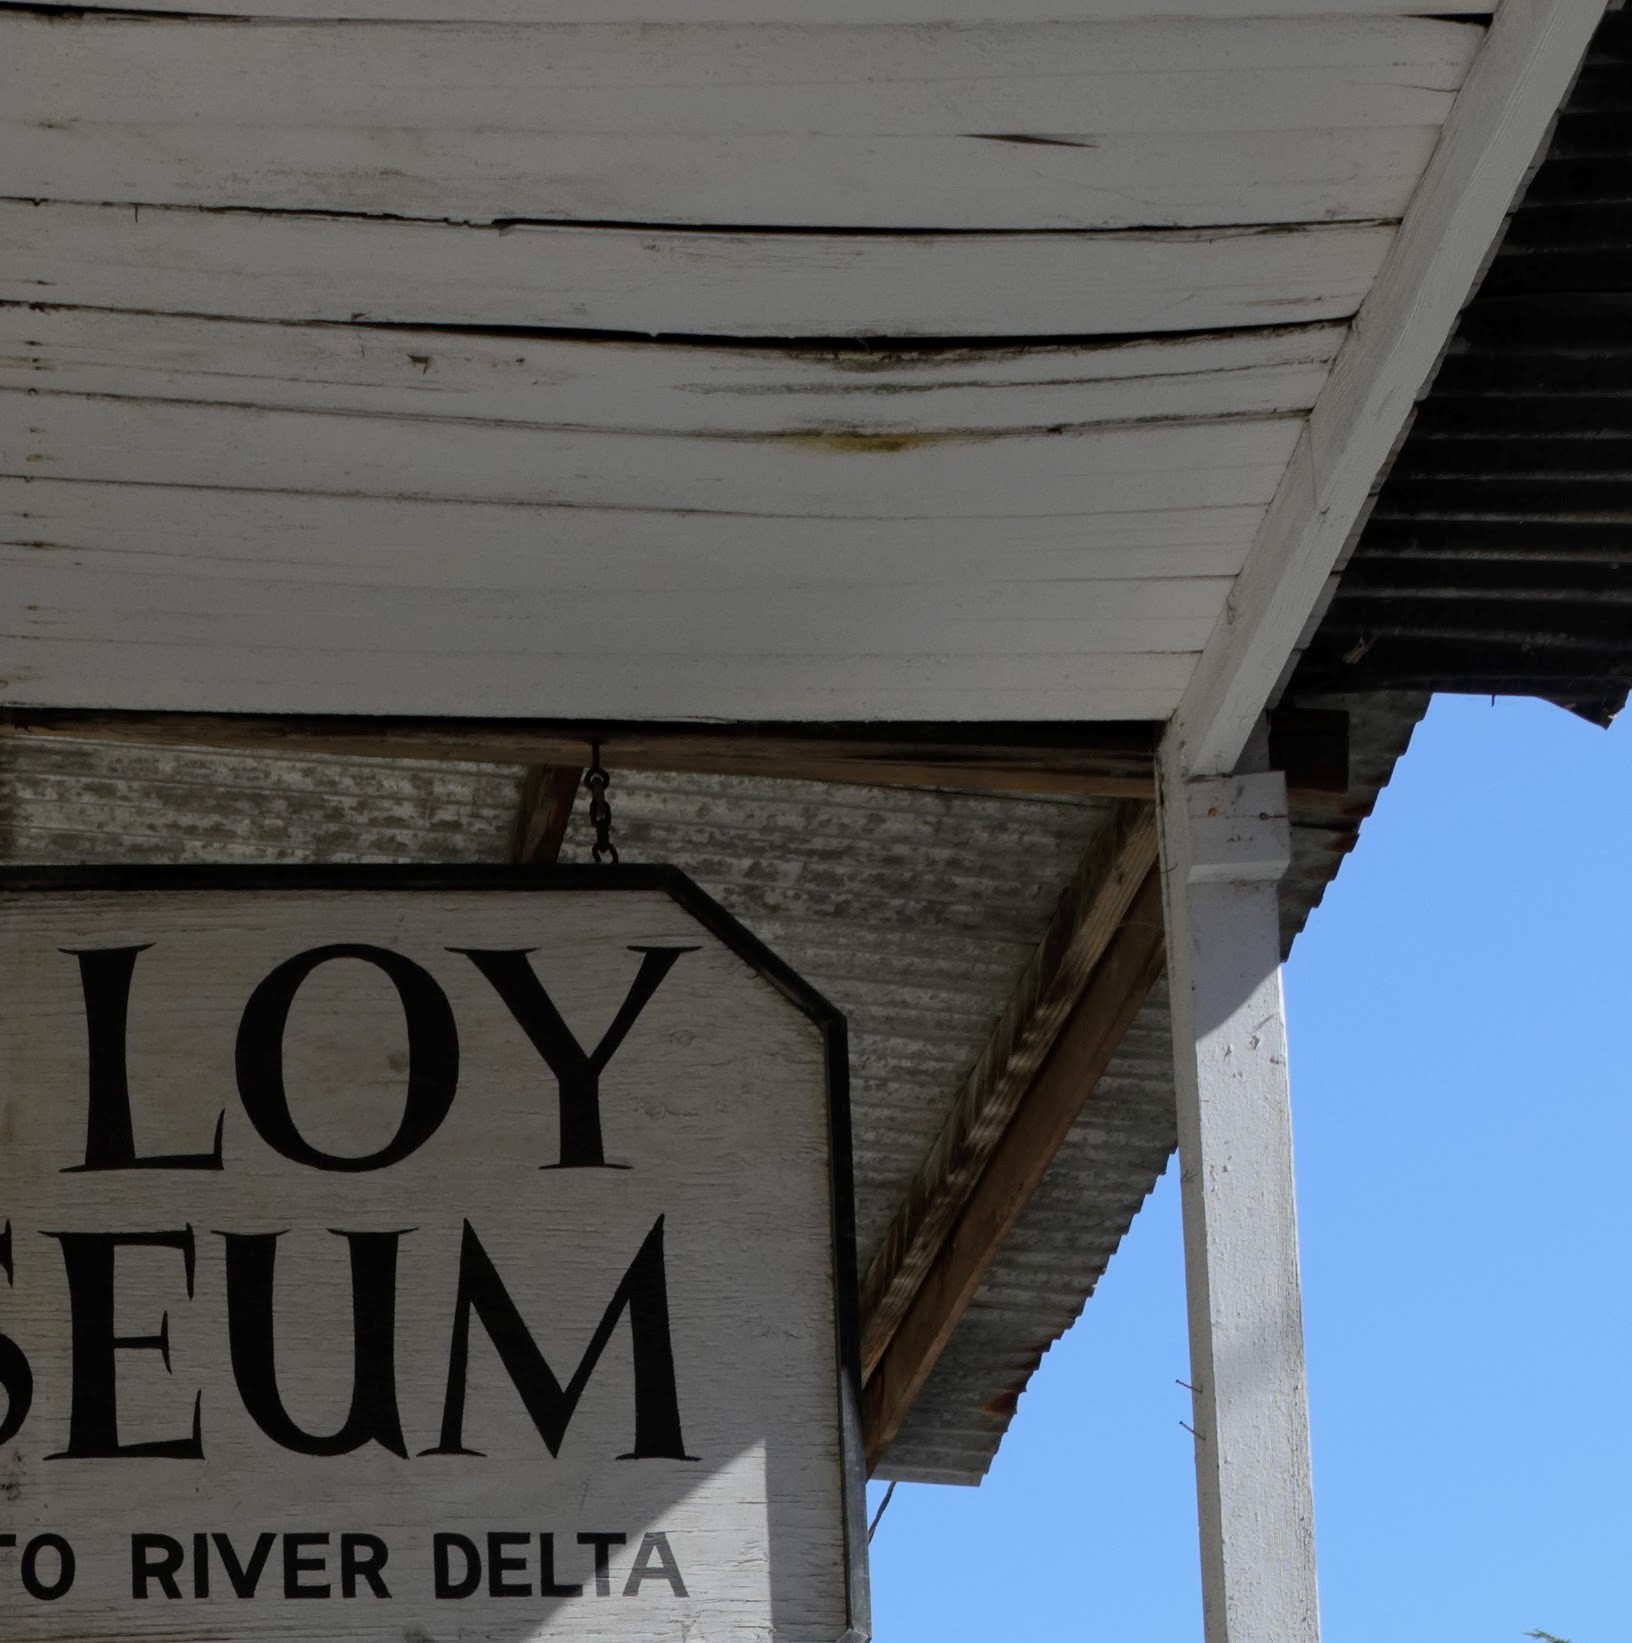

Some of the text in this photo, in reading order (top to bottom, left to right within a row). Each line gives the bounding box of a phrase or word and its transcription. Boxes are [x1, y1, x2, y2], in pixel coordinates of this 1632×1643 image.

[59, 943, 701, 1174] LOY
[132, 1530, 389, 1600] RIVER
[433, 1530, 689, 1600] DELTA
